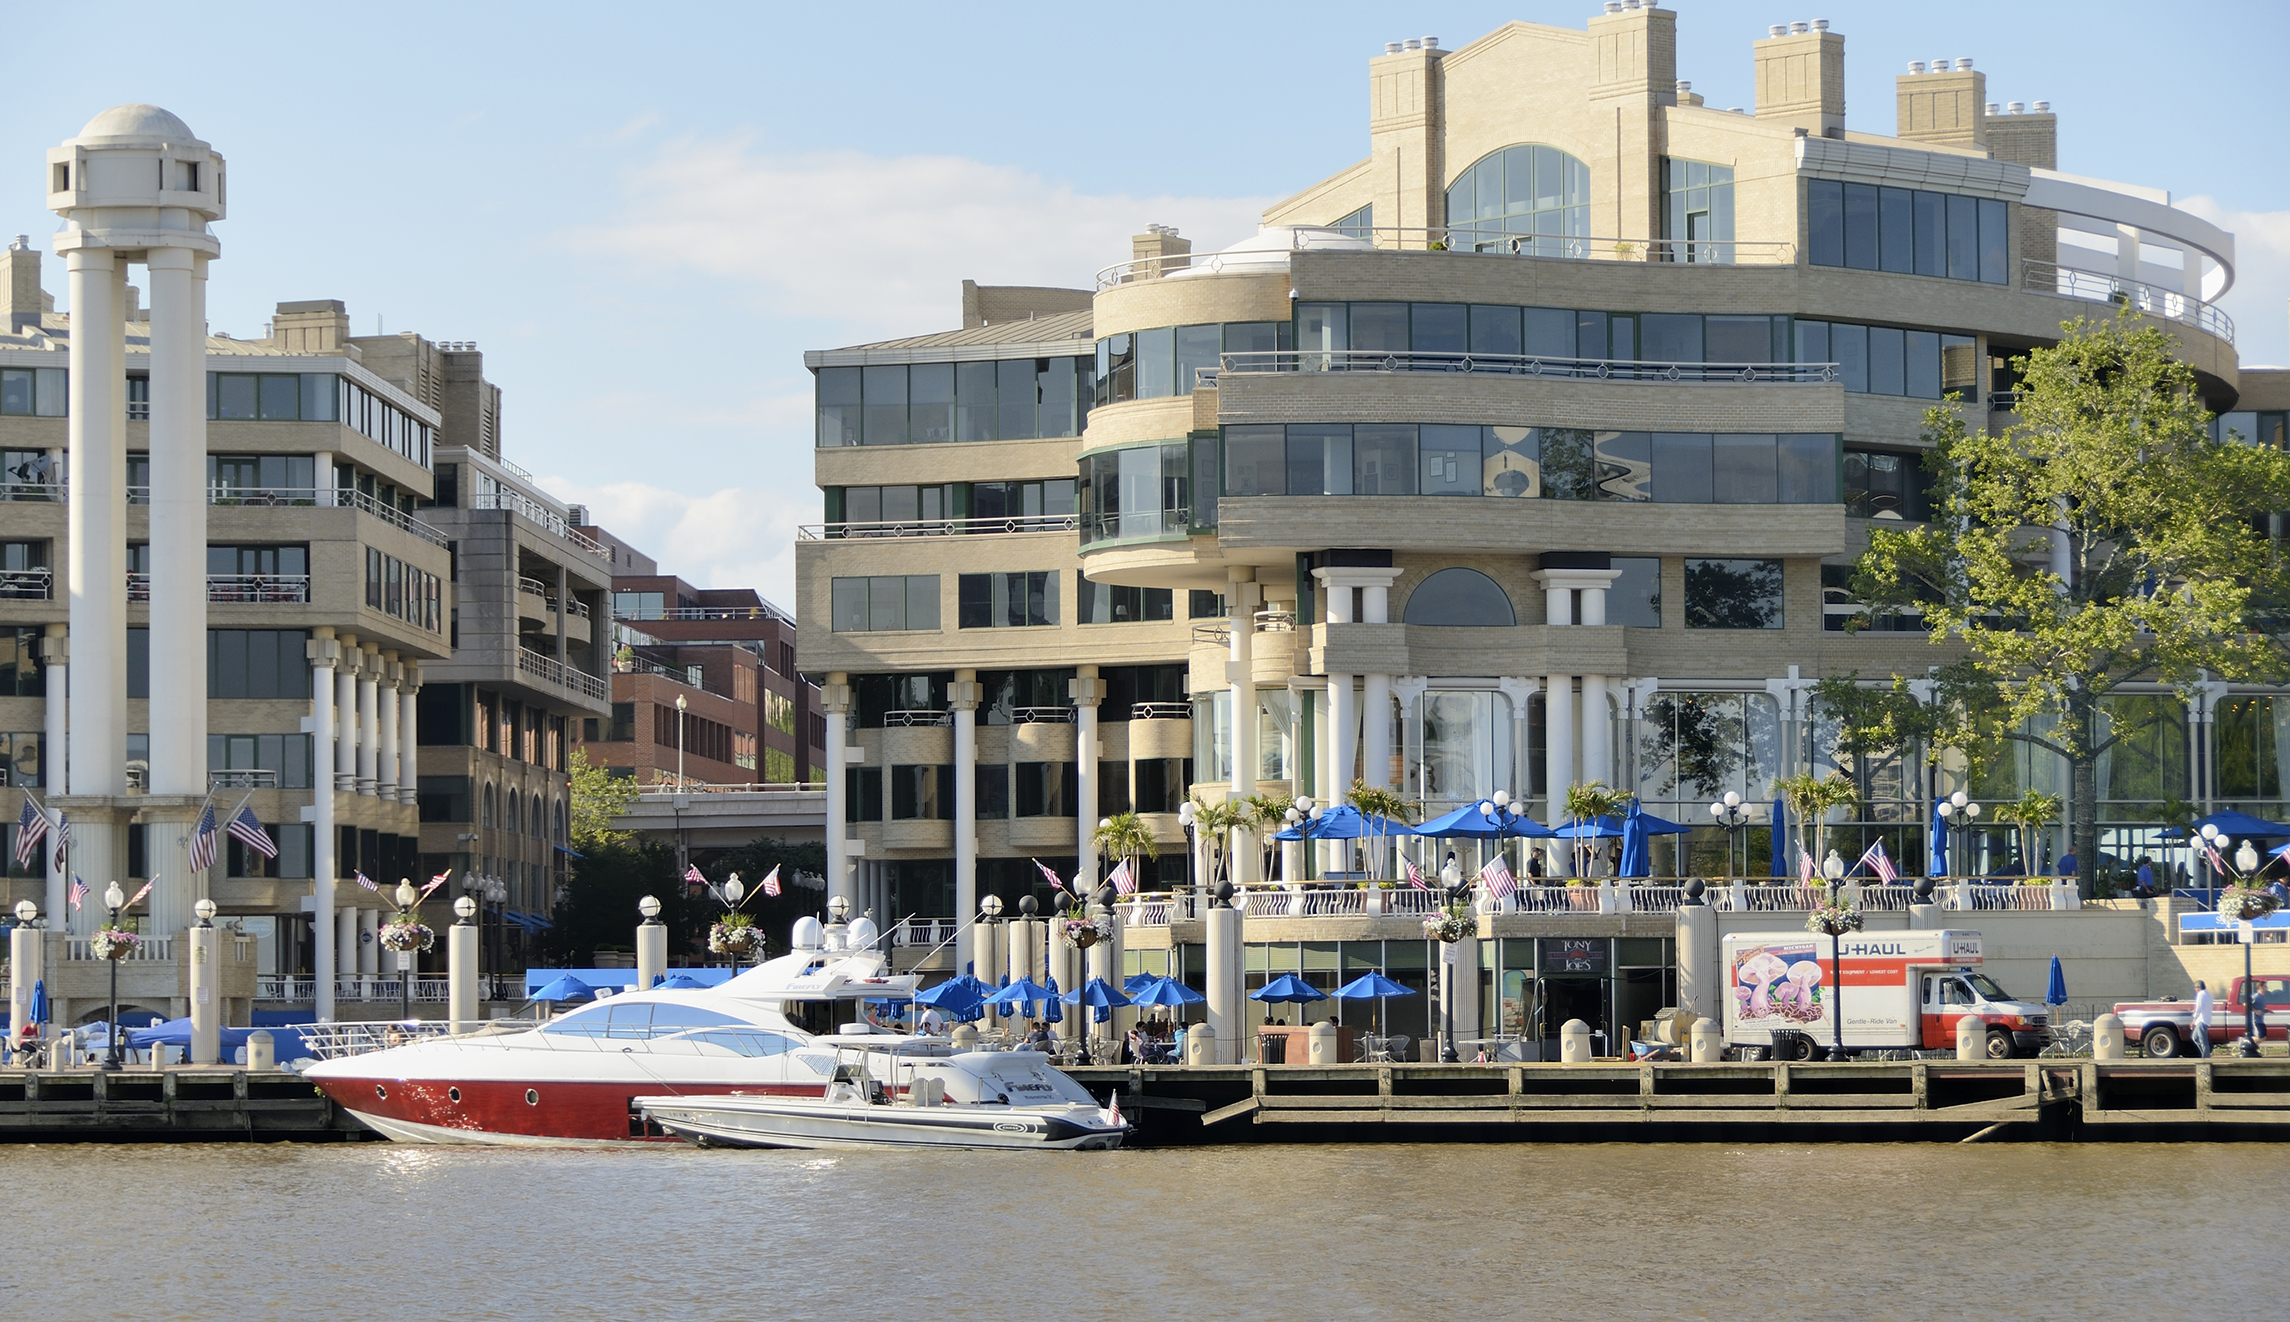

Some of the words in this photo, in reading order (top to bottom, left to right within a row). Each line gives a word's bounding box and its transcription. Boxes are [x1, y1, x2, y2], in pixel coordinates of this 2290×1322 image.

[1562, 941, 1592, 951] TONY
[1783, 943, 1814, 951] MICHIGAN
[1953, 942, 1979, 954] U-HAUL
[1564, 959, 1591, 971] JOE'S
[1004, 1081, 1053, 1092] FIREFLY
